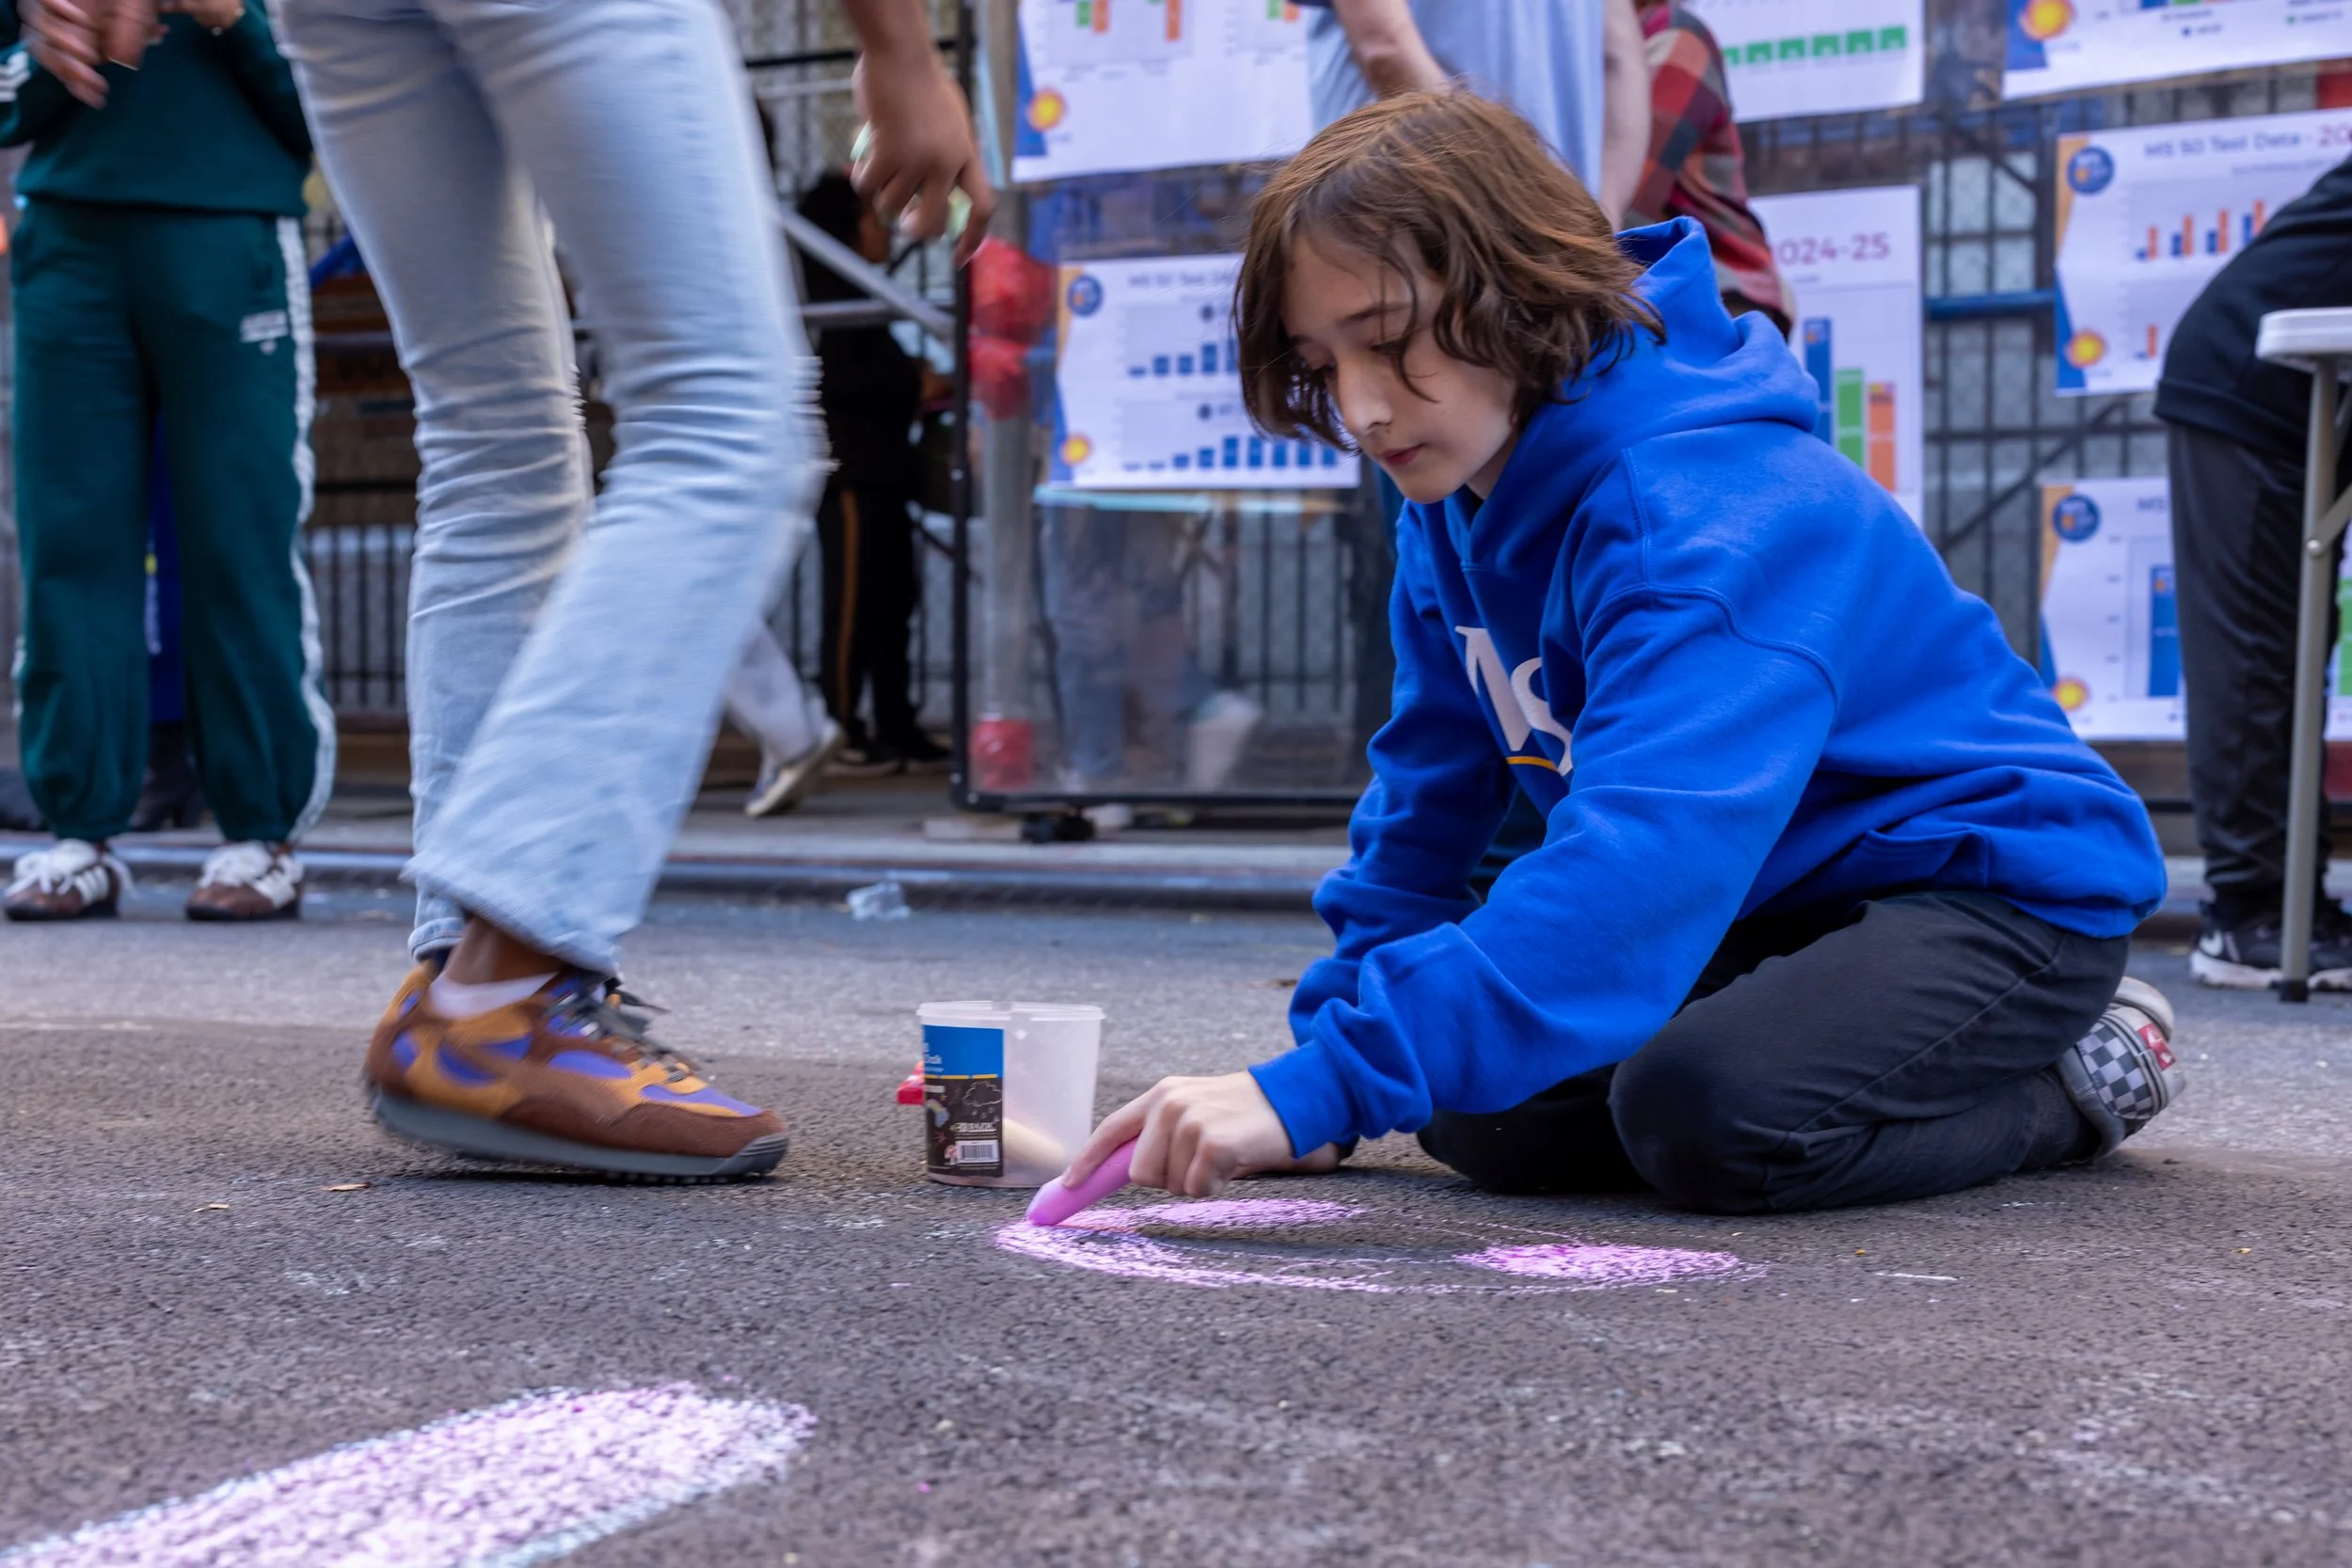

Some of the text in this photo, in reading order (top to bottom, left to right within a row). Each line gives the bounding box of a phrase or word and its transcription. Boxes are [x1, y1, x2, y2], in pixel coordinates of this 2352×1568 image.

[2144, 140, 2173, 157] MS
[2210, 135, 2248, 153] Test
[2254, 132, 2301, 150] Data
[1777, 231, 1891, 266] 024-25
